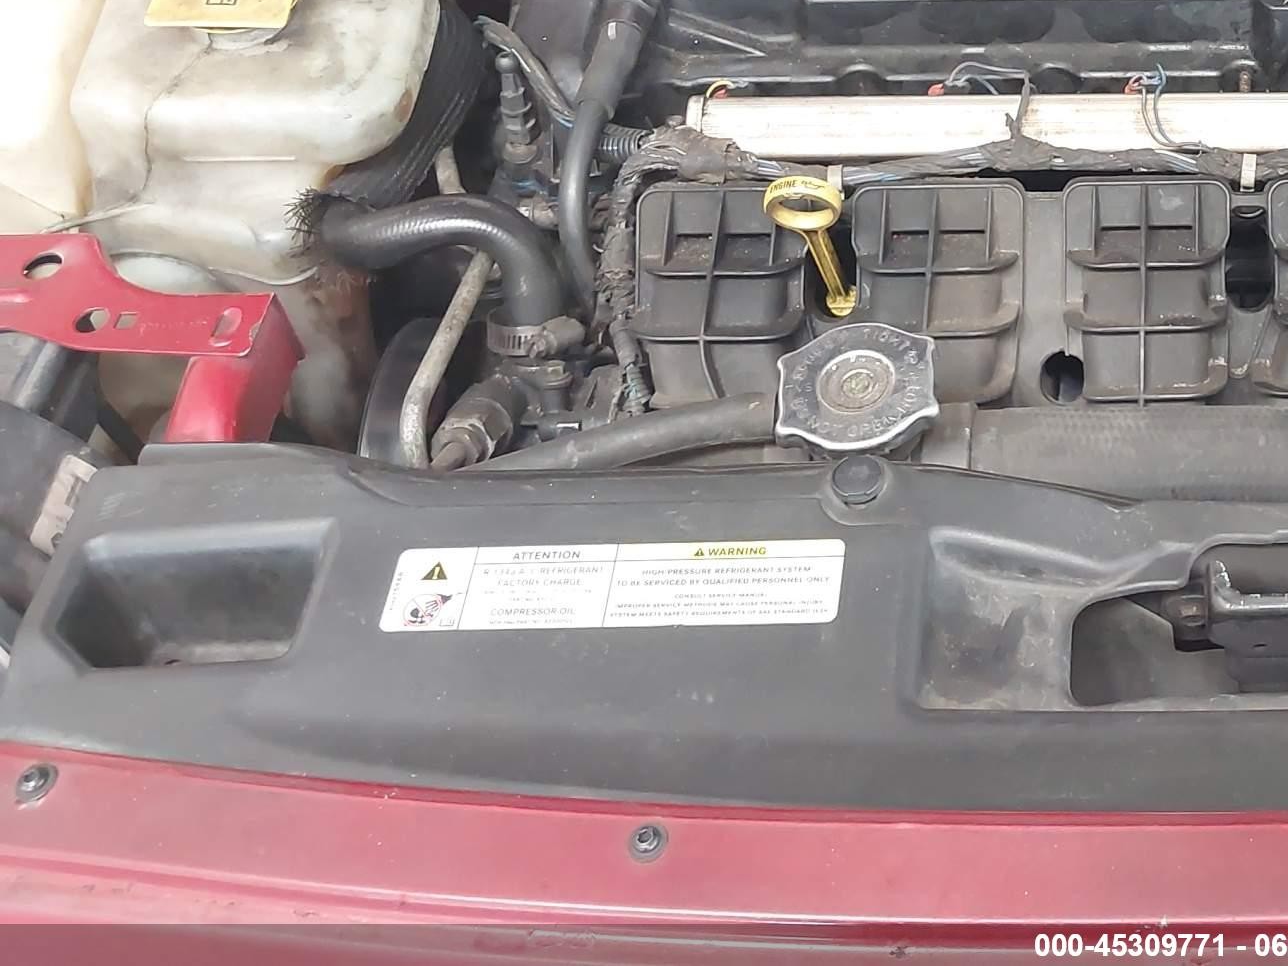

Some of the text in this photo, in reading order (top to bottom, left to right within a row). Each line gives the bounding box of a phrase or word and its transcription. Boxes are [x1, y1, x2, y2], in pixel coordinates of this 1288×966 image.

[512, 550, 582, 561] ATTENTION
[707, 546, 768, 556] WARNING
[714, 566, 774, 575] REFRIGERANT
[776, 565, 812, 573] SYSTEM
[643, 578, 687, 586] SERVICED
[702, 577, 750, 586] QUALIFIED
[806, 575, 830, 583] ONLY
[490, 607, 576, 617] COMPRESSOR OIL
